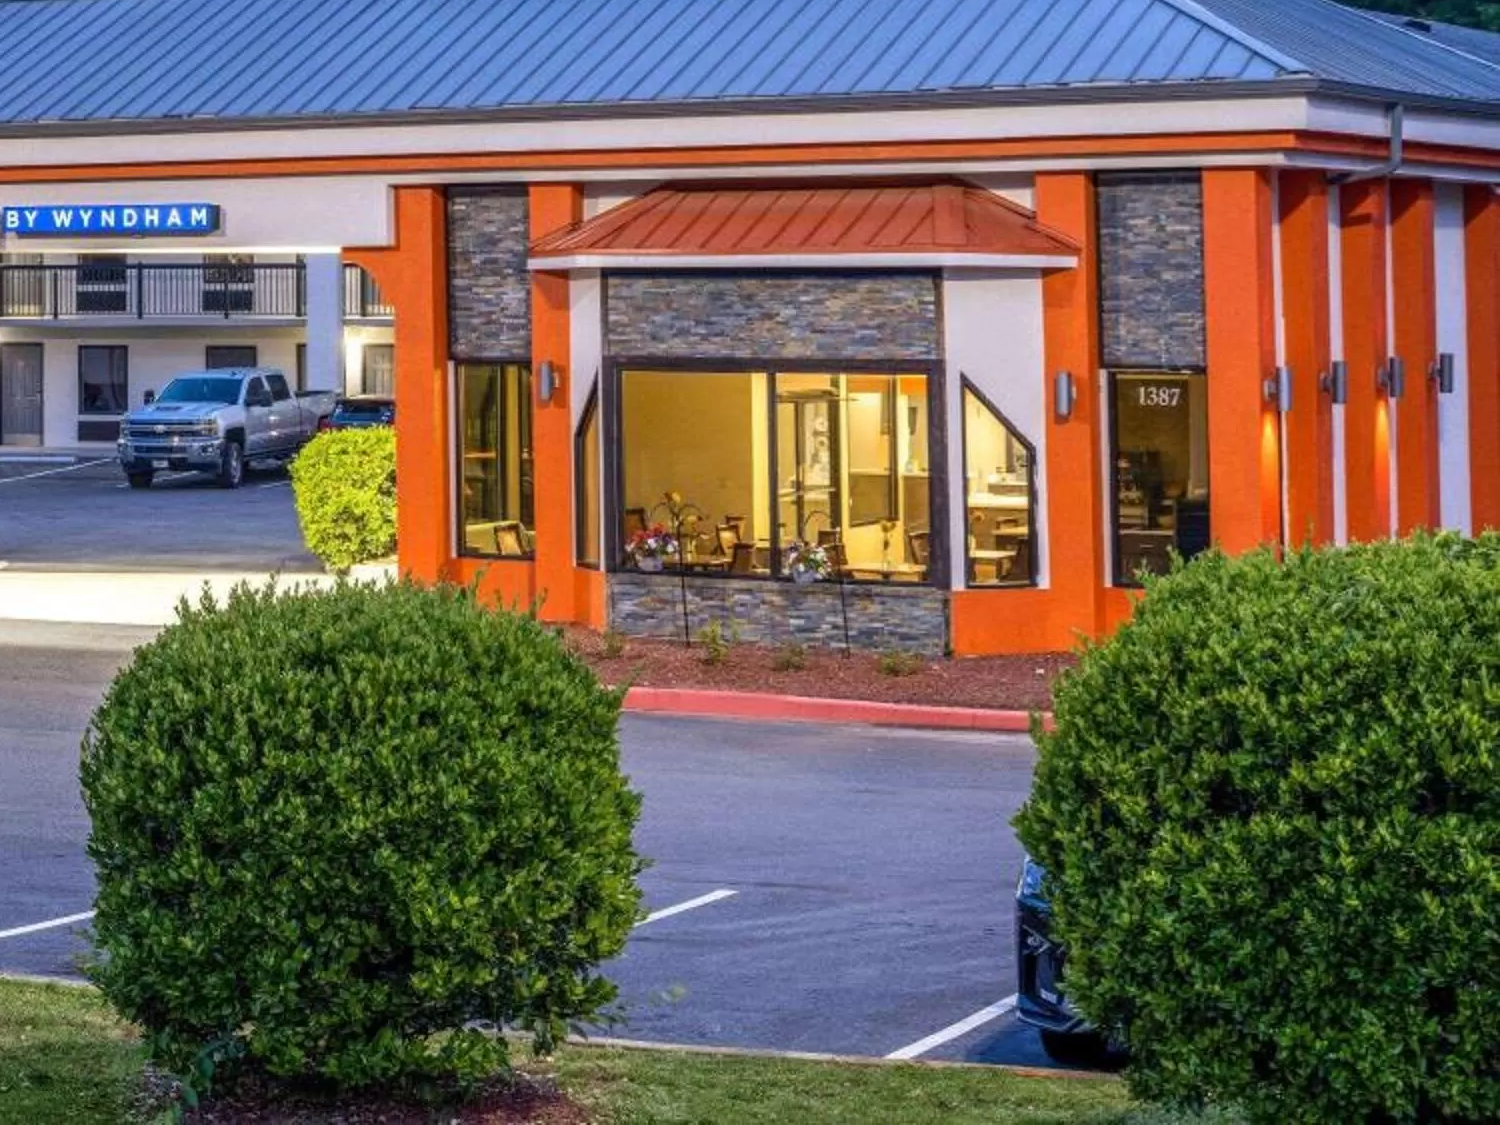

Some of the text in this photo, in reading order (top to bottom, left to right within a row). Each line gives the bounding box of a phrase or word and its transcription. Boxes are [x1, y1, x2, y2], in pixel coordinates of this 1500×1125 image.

[6, 207, 208, 228] BY WYNDHAM
[1139, 386, 1181, 406] 1387
